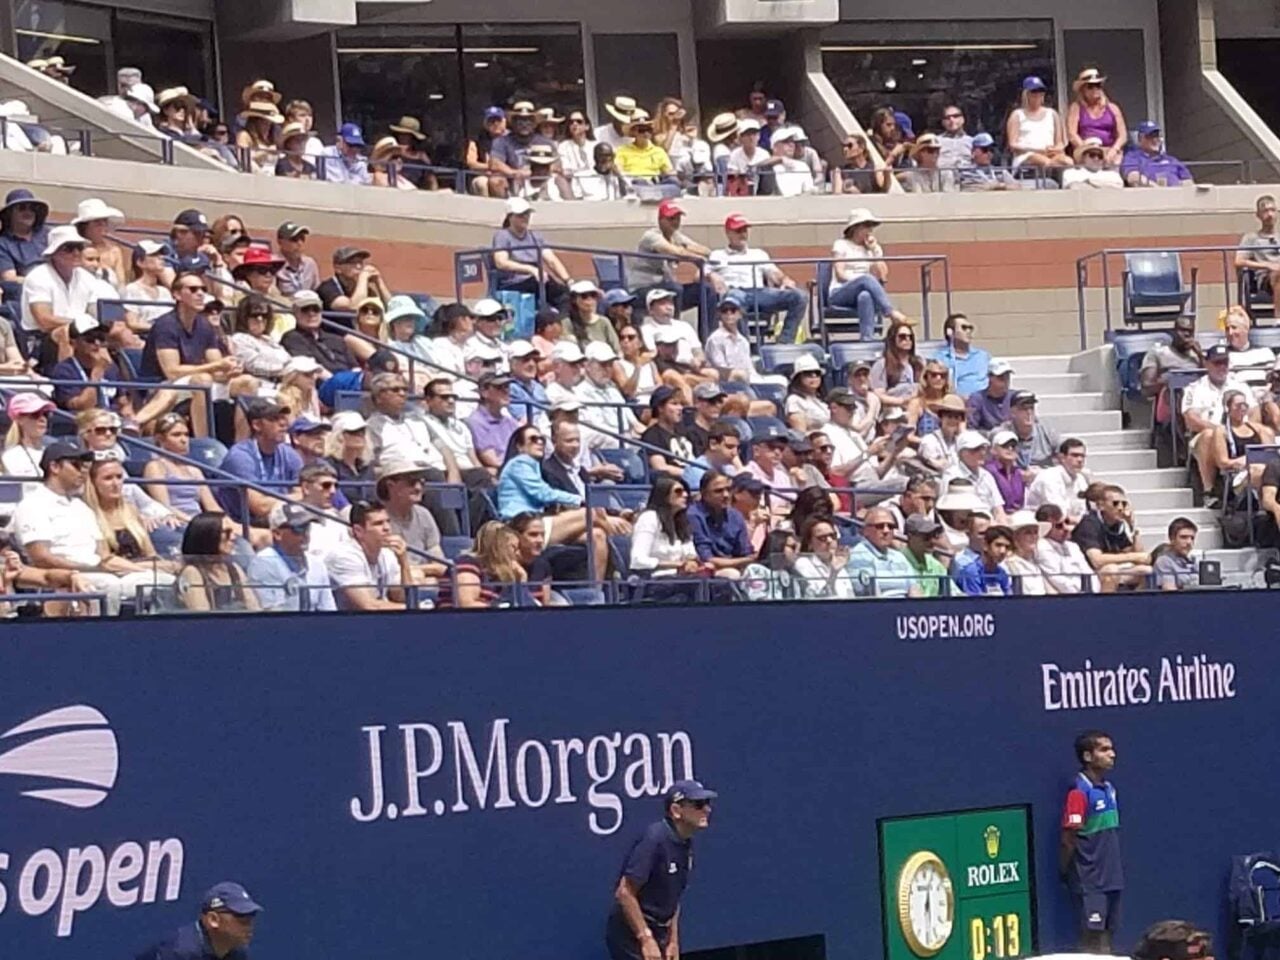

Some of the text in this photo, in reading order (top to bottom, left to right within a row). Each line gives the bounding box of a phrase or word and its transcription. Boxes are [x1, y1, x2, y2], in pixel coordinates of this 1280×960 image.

[897, 614, 995, 639] USOPEN.ORG
[1041, 655, 1236, 710] Emirates Airline
[350, 718, 694, 835] J.P.Morgan
[967, 862, 1020, 887] ROLEX
